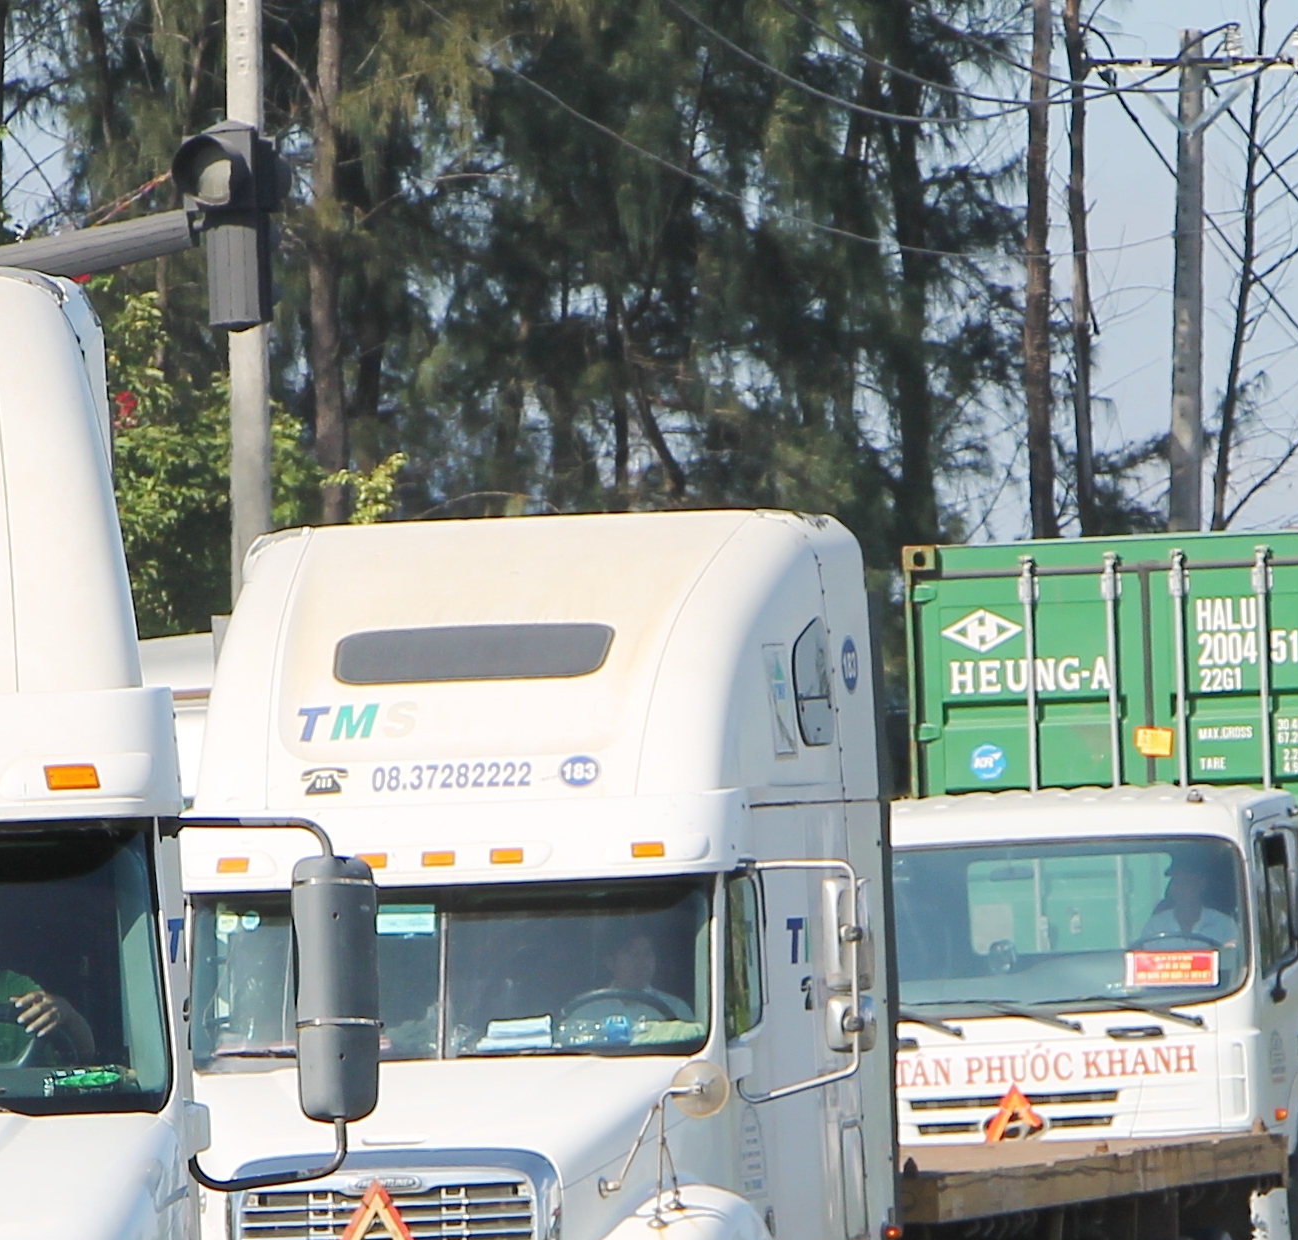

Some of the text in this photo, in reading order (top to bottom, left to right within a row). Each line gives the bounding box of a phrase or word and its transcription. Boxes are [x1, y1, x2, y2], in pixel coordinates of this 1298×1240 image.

[1195, 597, 1257, 631] HALU
[950, 655, 1112, 694] HEUNG-A
[1200, 667, 1243, 693] 22G1
[297, 700, 419, 742] TMS
[1198, 725, 1253, 741] MAX.GROSS
[371, 760, 598, 793] 08.37282222 183
[1200, 756, 1227, 771] TARE
[896, 1052, 953, 1088] TÂN
[1083, 1044, 1199, 1080] KHANH
